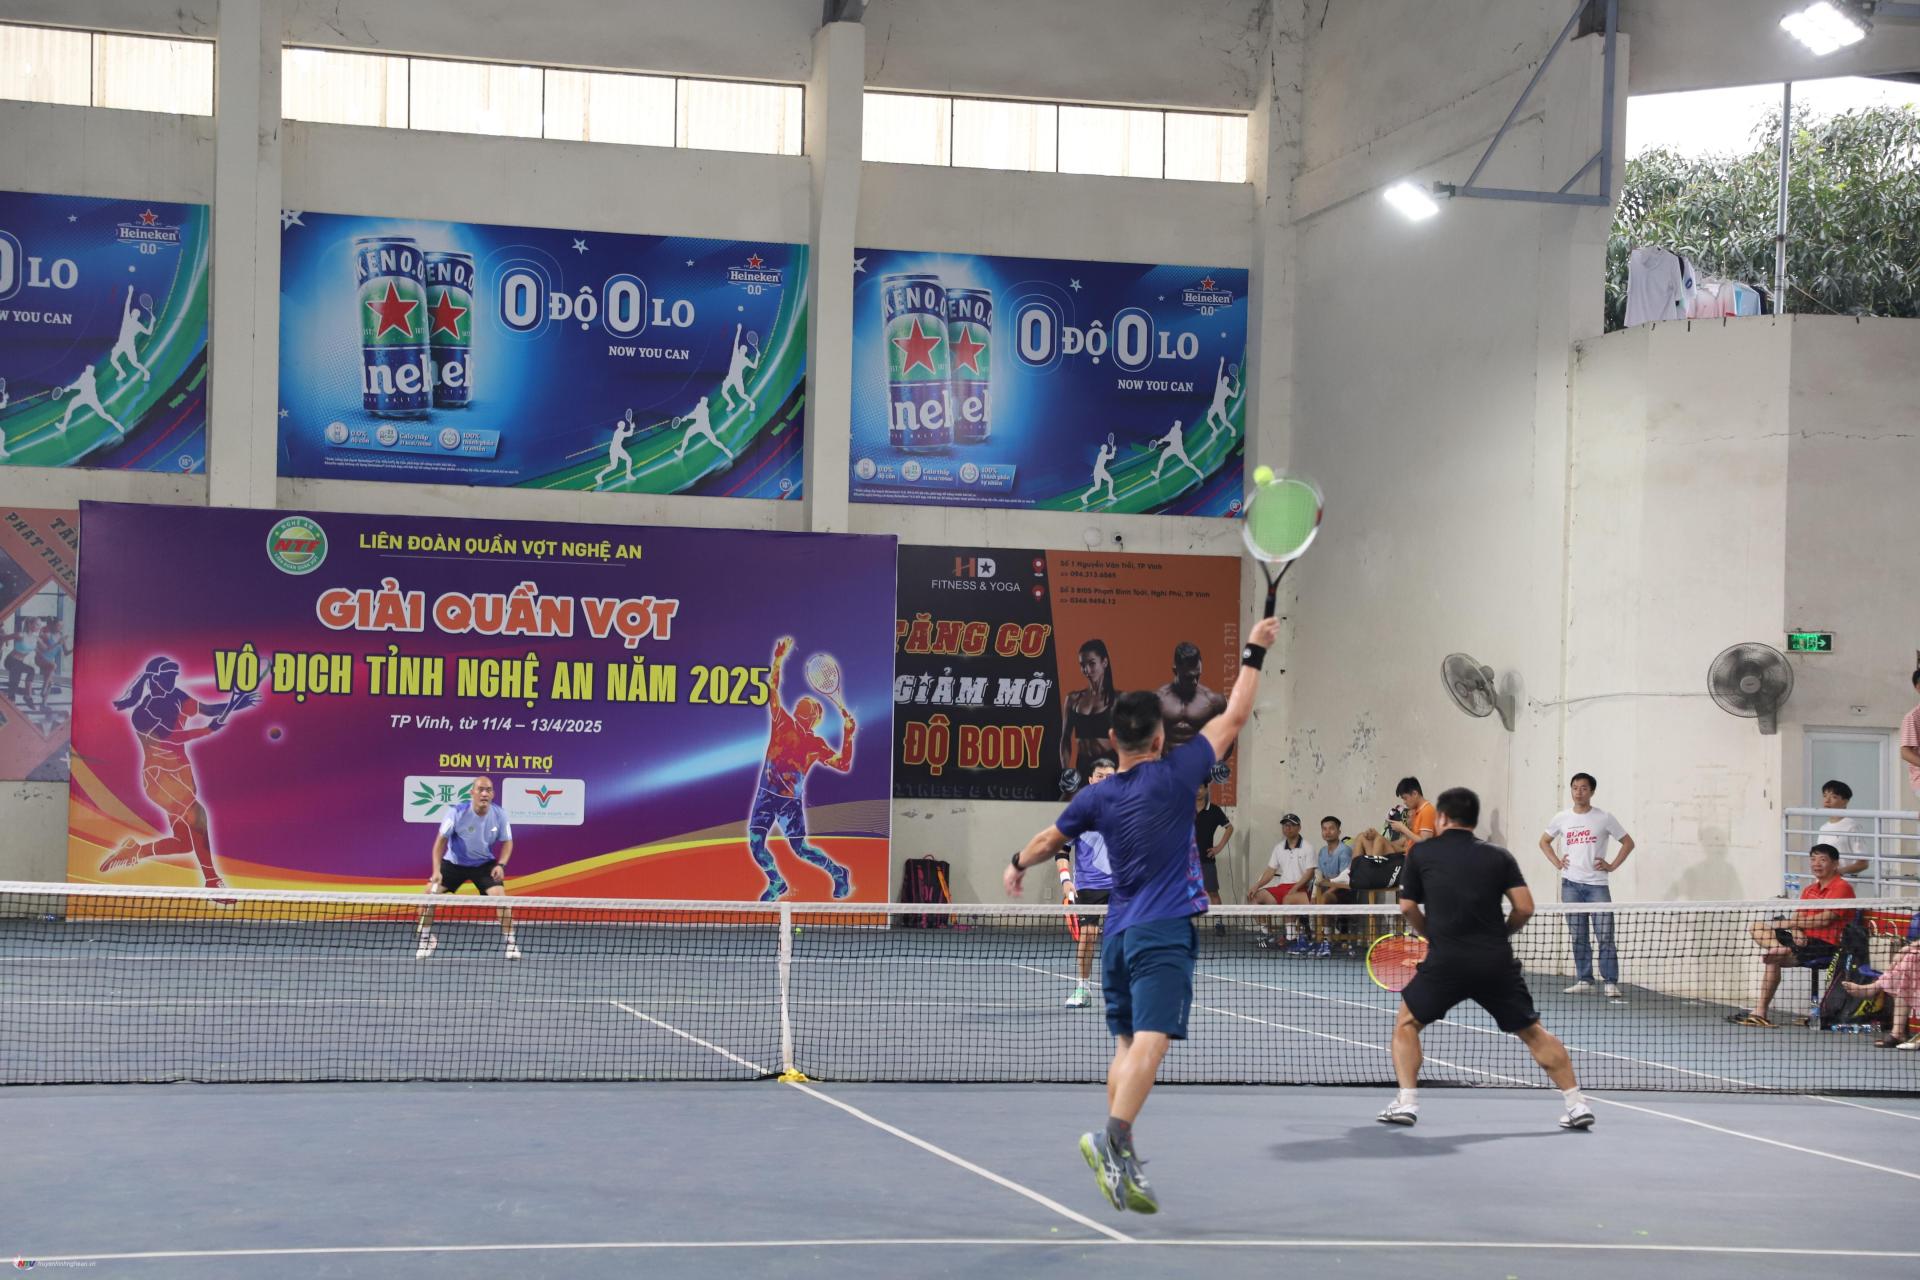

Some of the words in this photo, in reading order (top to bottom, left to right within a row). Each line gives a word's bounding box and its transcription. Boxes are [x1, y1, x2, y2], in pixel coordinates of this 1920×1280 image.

[120, 227, 178, 242] Heineken
[27, 256, 79, 290] LO
[730, 270, 779, 283] Heineken
[549, 285, 598, 332] ĐỘ
[651, 298, 696, 328] LO
[1184, 292, 1231, 304] Heineken
[13, 310, 40, 324] YOU
[43, 312, 73, 325] CAN
[608, 345, 636, 358] NOW
[638, 347, 663, 359] YOU
[664, 348, 690, 361] CAN
[1062, 319, 1107, 365] ĐỘ
[1158, 331, 1199, 360] LO
[1117, 379, 1144, 391] NOW
[1146, 381, 1168, 392] YOU
[1170, 381, 1194, 393] CAN
[359, 531, 402, 549] LIÊN
[407, 534, 461, 552] ĐOÀN
[465, 533, 517, 555] QUẦN
[521, 539, 557, 559] VỢT
[562, 541, 611, 562] NGHỆ
[615, 544, 642, 560] AN
[931, 580, 977, 591] FITNESS
[979, 582, 987, 591] &
[990, 582, 1021, 592] YOGA
[316, 577, 425, 632] GIẢI
[433, 582, 573, 638] QUẦN
[580, 594, 679, 649] VỢT
[995, 622, 1052, 658] CƠ
[214, 643, 260, 693] VÔ
[272, 652, 352, 704] ĐỊCH
[365, 644, 444, 697] TỈNH
[457, 651, 540, 709] NGHỆ
[551, 661, 593, 701] AN
[606, 655, 677, 703] NĂM
[688, 665, 770, 706] 2025
[994, 671, 1053, 708] MỠ
[390, 714, 411, 729] TP
[415, 715, 454, 731] Vinh,
[459, 716, 479, 731] từ
[482, 716, 512, 731] 11/4
[530, 718, 603, 733] 13/4/2025
[903, 713, 950, 776] ĐỘ
[958, 724, 1044, 769] BODY
[439, 753, 472, 768] ĐƠN
[475, 754, 491, 772] VỊ
[494, 753, 519, 769] TÀI
[522, 754, 553, 773] TRỢ
